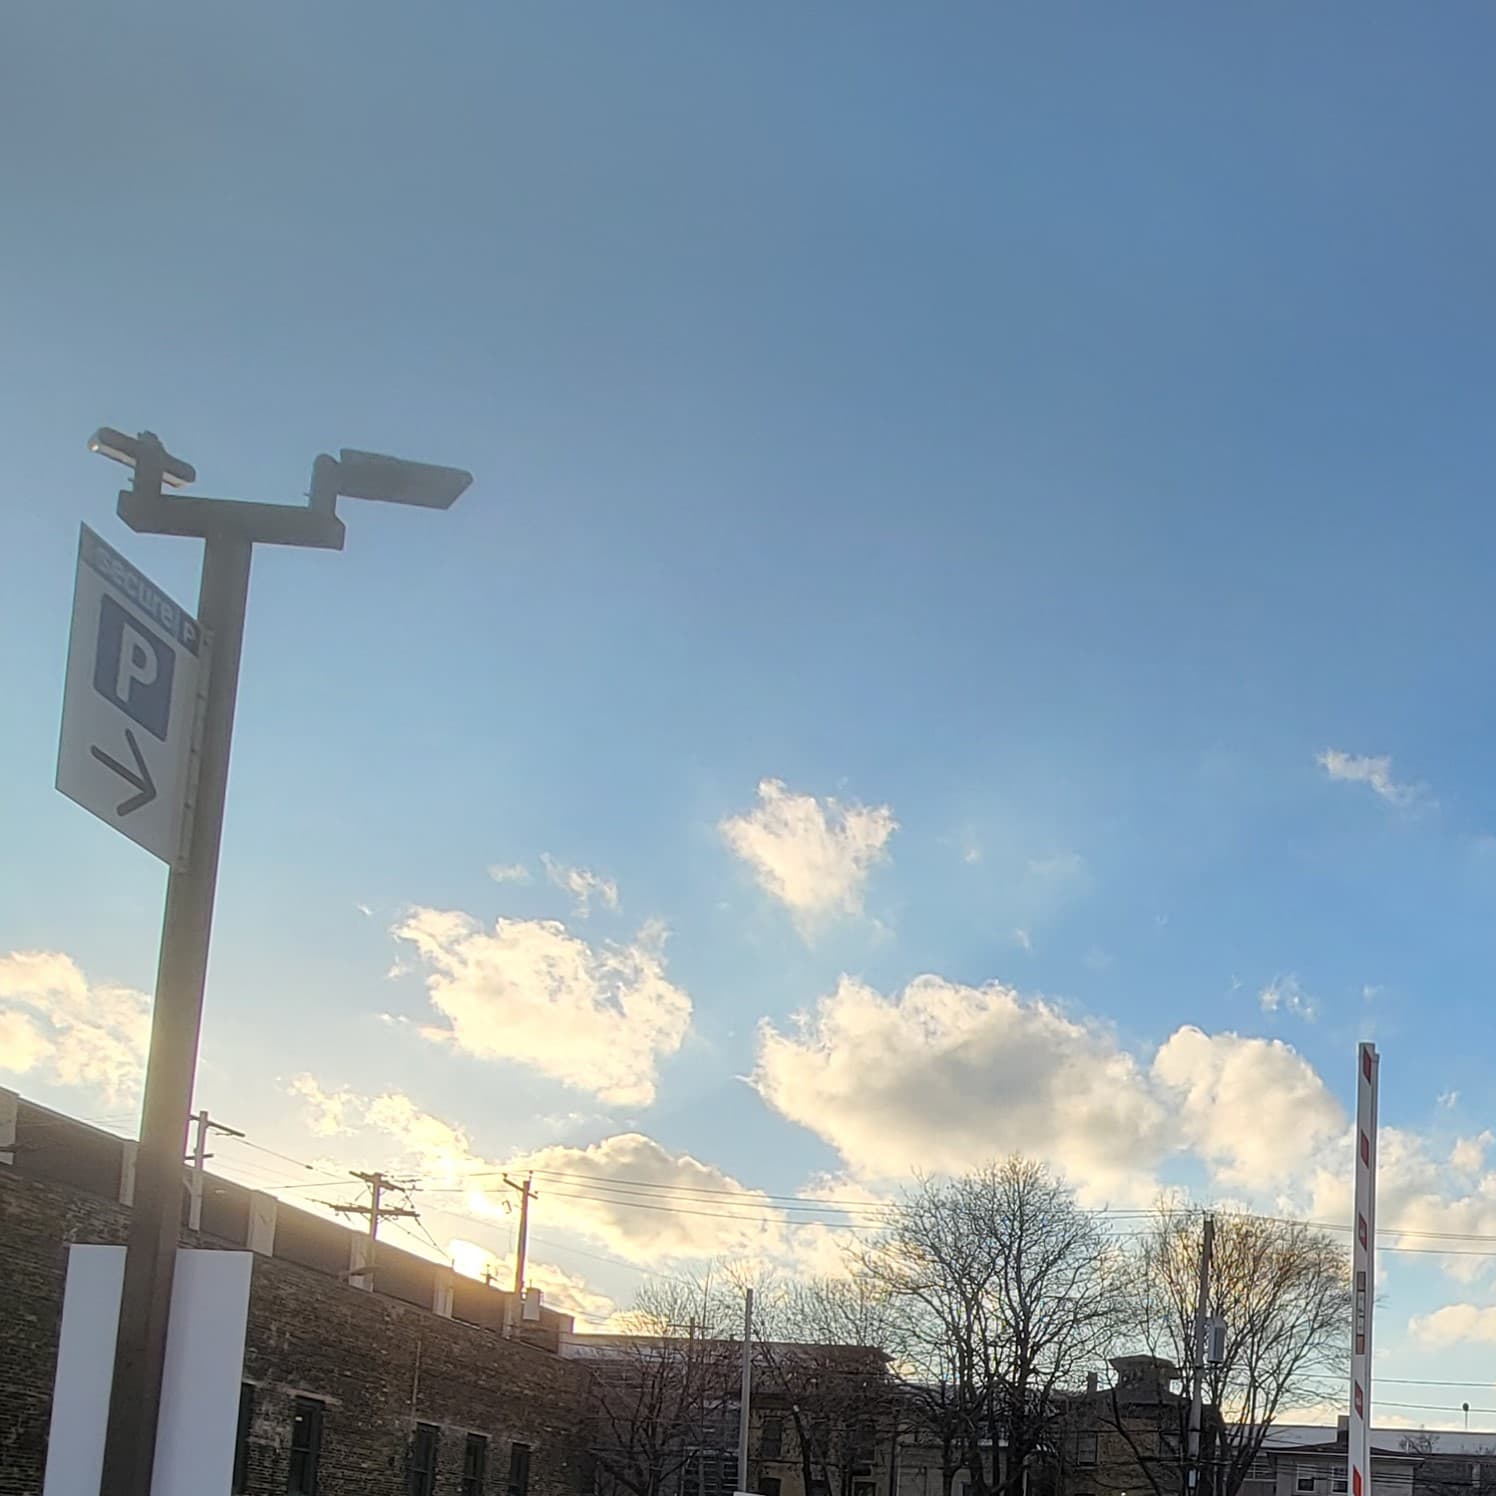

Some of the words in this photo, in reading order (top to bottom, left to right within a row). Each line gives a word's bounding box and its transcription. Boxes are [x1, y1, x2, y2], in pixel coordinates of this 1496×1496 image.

[96, 547, 175, 630] secure
[183, 621, 196, 643] P
[116, 622, 158, 703] P
